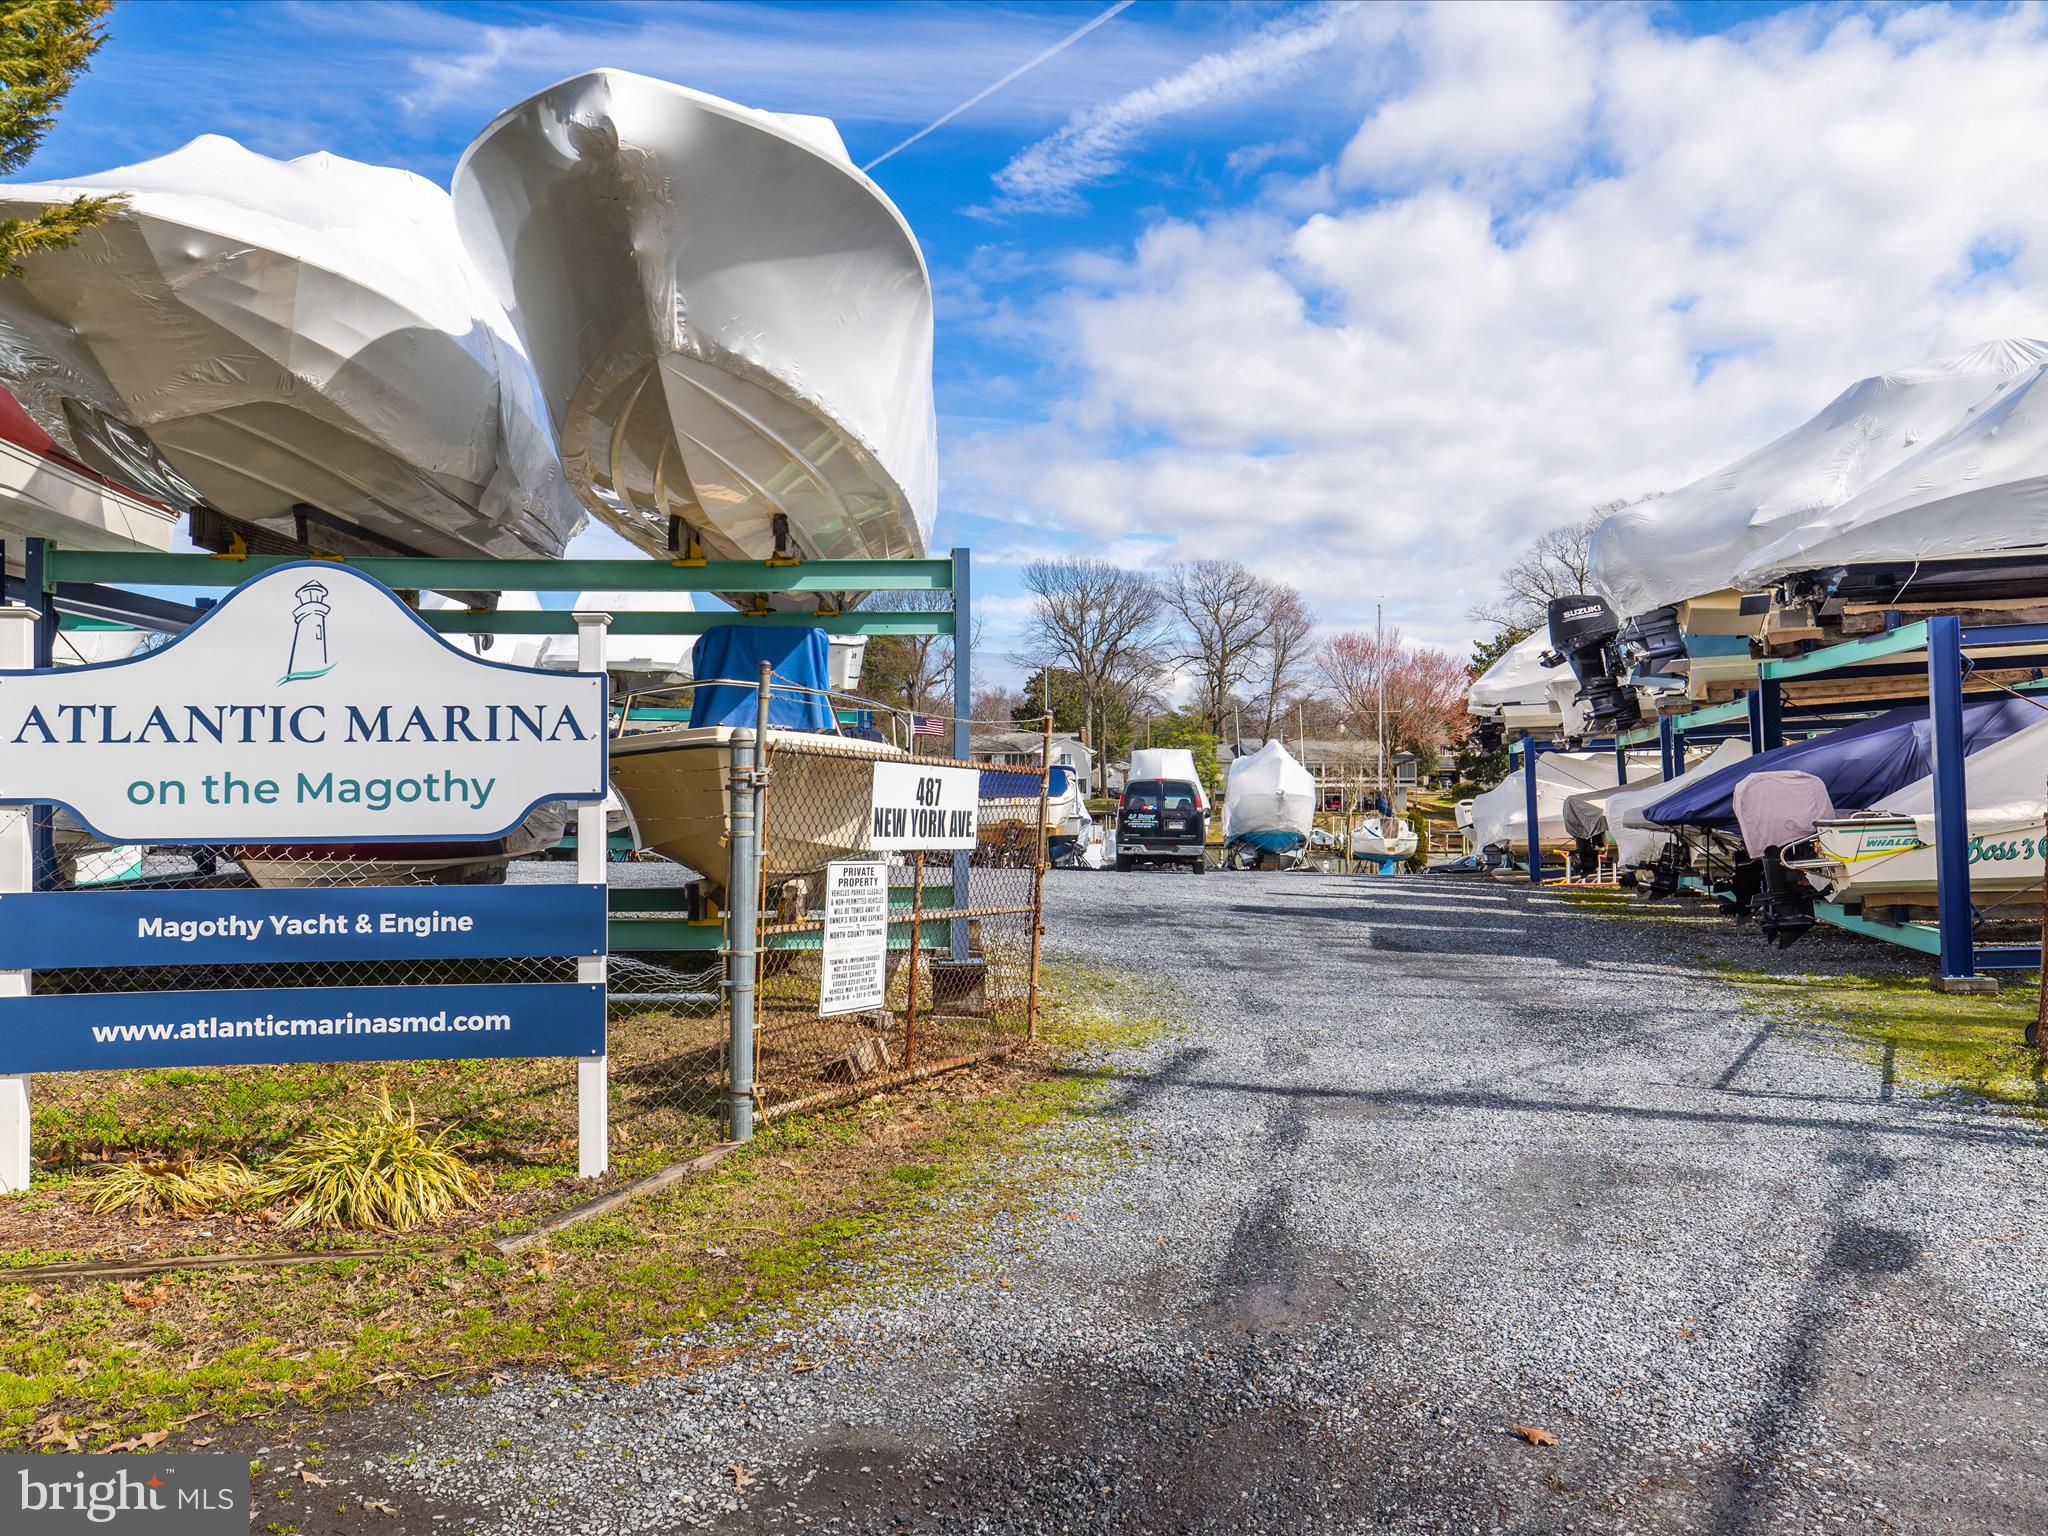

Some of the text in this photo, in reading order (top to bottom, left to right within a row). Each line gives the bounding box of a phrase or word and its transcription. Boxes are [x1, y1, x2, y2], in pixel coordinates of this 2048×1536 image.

[1563, 604, 1601, 619] SUZUKI
[11, 703, 588, 744] ATLANTIC MARINA
[127, 769, 496, 811] on the Magothy
[916, 777, 942, 806] 487
[873, 807, 975, 838] NEW YORK AVE.
[1866, 838, 1920, 847] WHALER
[843, 867, 875, 877] PRIVATE
[838, 877, 878, 887] PROPERTY
[831, 889, 850, 897] VEHICLES
[851, 888, 866, 896] PARKED
[868, 896, 884, 904] VEHICLES
[851, 906, 864, 914] TOWED
[829, 917, 848, 925] OWNER'S
[868, 914, 884, 922] EXPENSE
[138, 911, 474, 941] Magothy Yacht & Engine
[830, 928, 882, 940] NORTH COUNTY TOWING
[830, 958, 844, 966] TOWING
[849, 956, 865, 964] IMPOUND
[865, 954, 880, 962] CHARGES
[832, 980, 847, 988] EXCEED
[859, 983, 878, 991] RECLAIMED
[92, 1011, 511, 1043] www.atlanticmarinasmd.com
